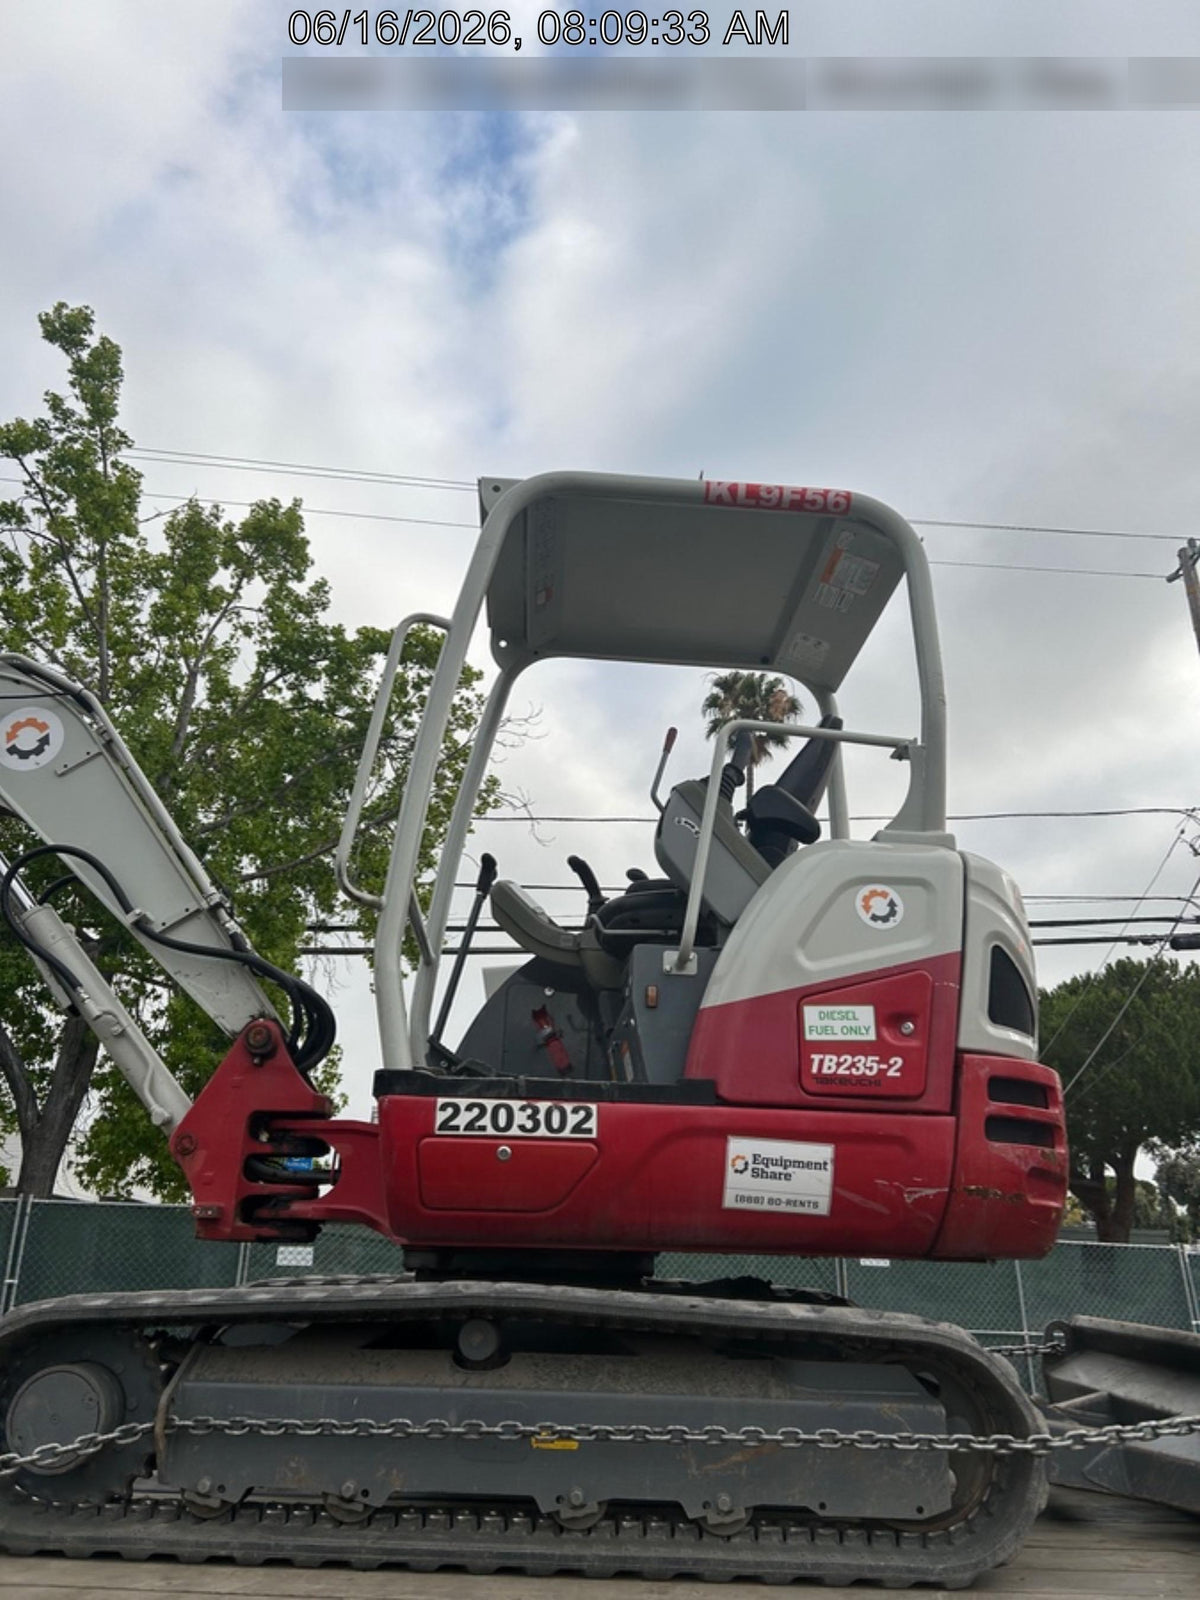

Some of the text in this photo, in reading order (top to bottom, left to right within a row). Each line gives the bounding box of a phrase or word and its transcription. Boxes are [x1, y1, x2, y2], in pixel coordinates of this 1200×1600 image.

[707, 481, 848, 513] KL9F56
[818, 1010, 859, 1021] DIESEL
[808, 1025, 871, 1036] FUEL ONLY
[810, 1053, 903, 1077] TB235-2
[437, 1101, 593, 1135] 220302
[752, 1153, 829, 1171] Equipment
[751, 1167, 793, 1181] Share
